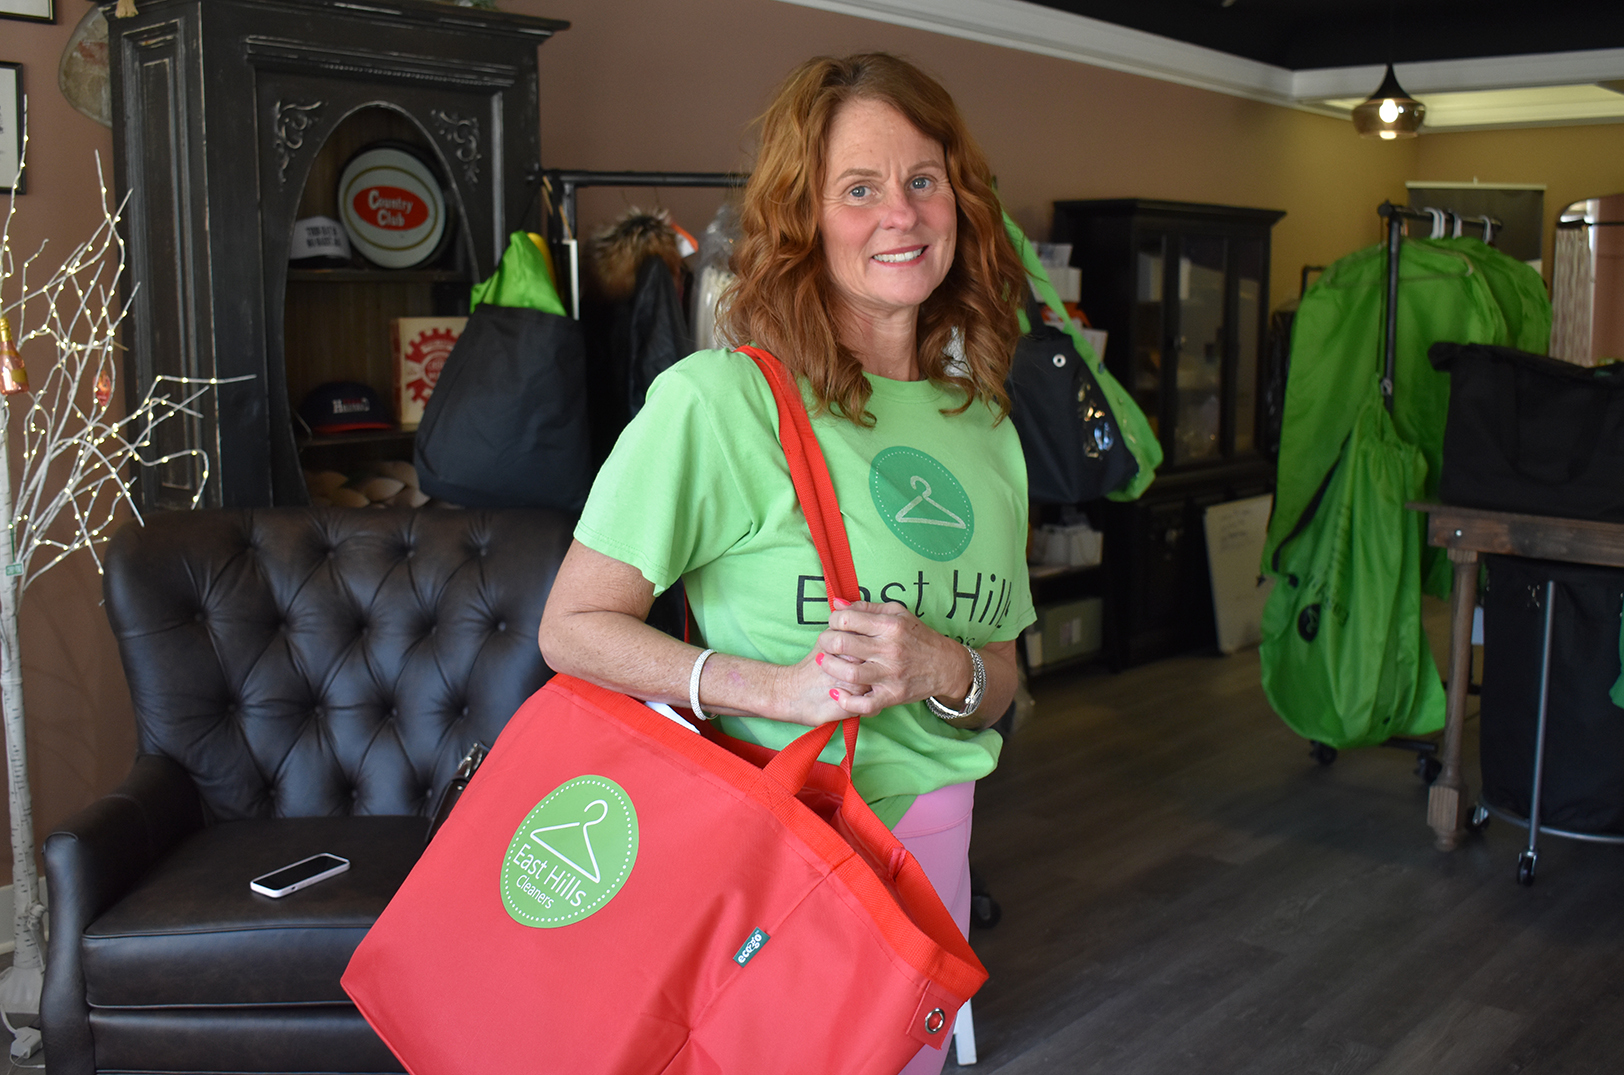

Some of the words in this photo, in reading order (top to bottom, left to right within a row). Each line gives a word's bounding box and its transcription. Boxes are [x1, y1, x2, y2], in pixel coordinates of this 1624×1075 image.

[368, 189, 414, 215] Country
[377, 209, 405, 228] Club
[796, 571, 930, 625] Est
[513, 843, 548, 880] East
[543, 865, 587, 907] Hills
[516, 874, 555, 909] Cleaners
